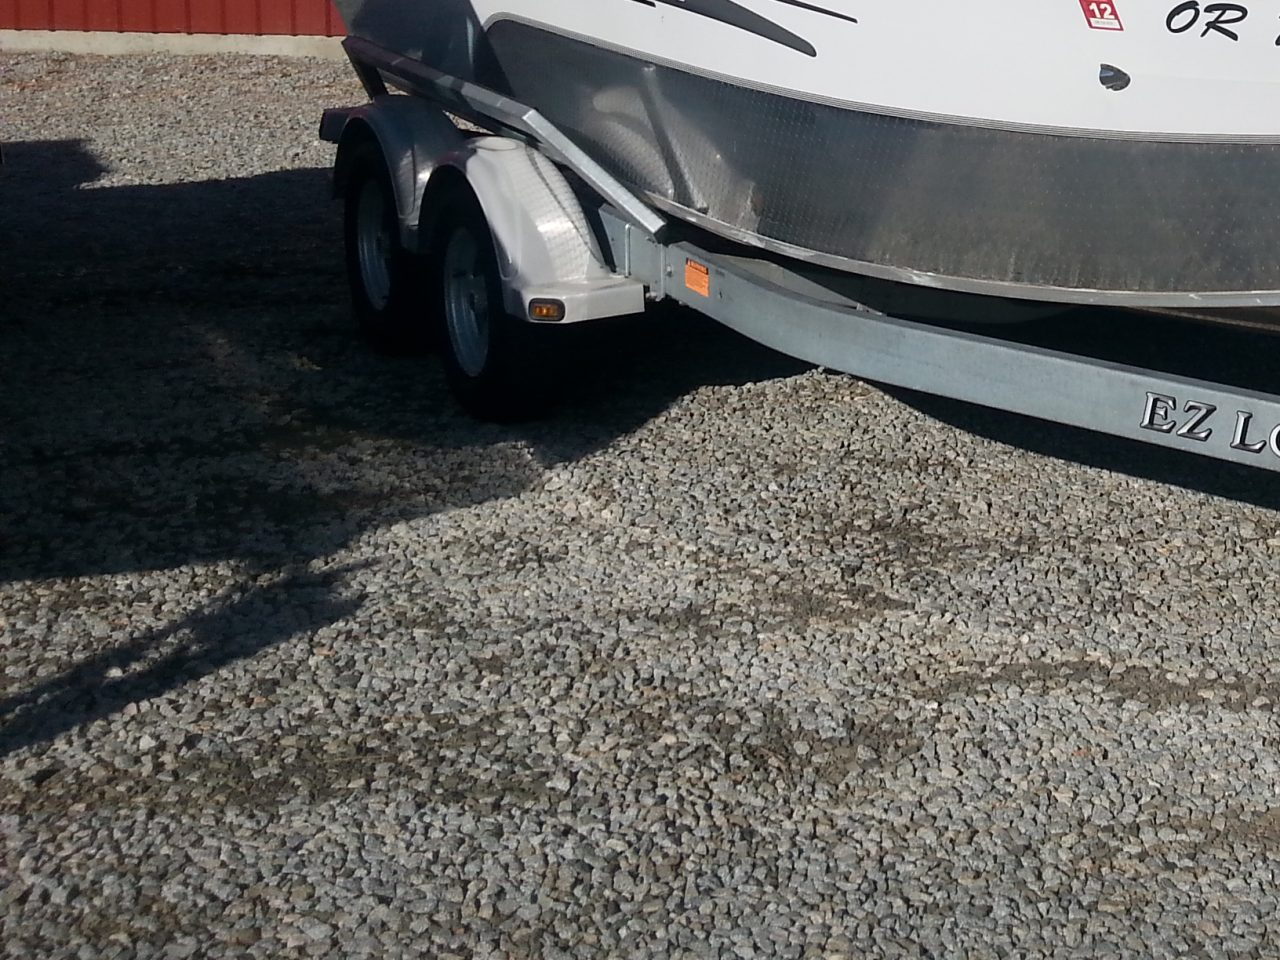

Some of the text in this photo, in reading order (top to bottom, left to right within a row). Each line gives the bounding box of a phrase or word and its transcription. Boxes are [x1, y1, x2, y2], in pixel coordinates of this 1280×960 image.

[1089, 2, 1115, 19] 12
[1166, 0, 1248, 41] OR
[1140, 392, 1217, 441] EZ
